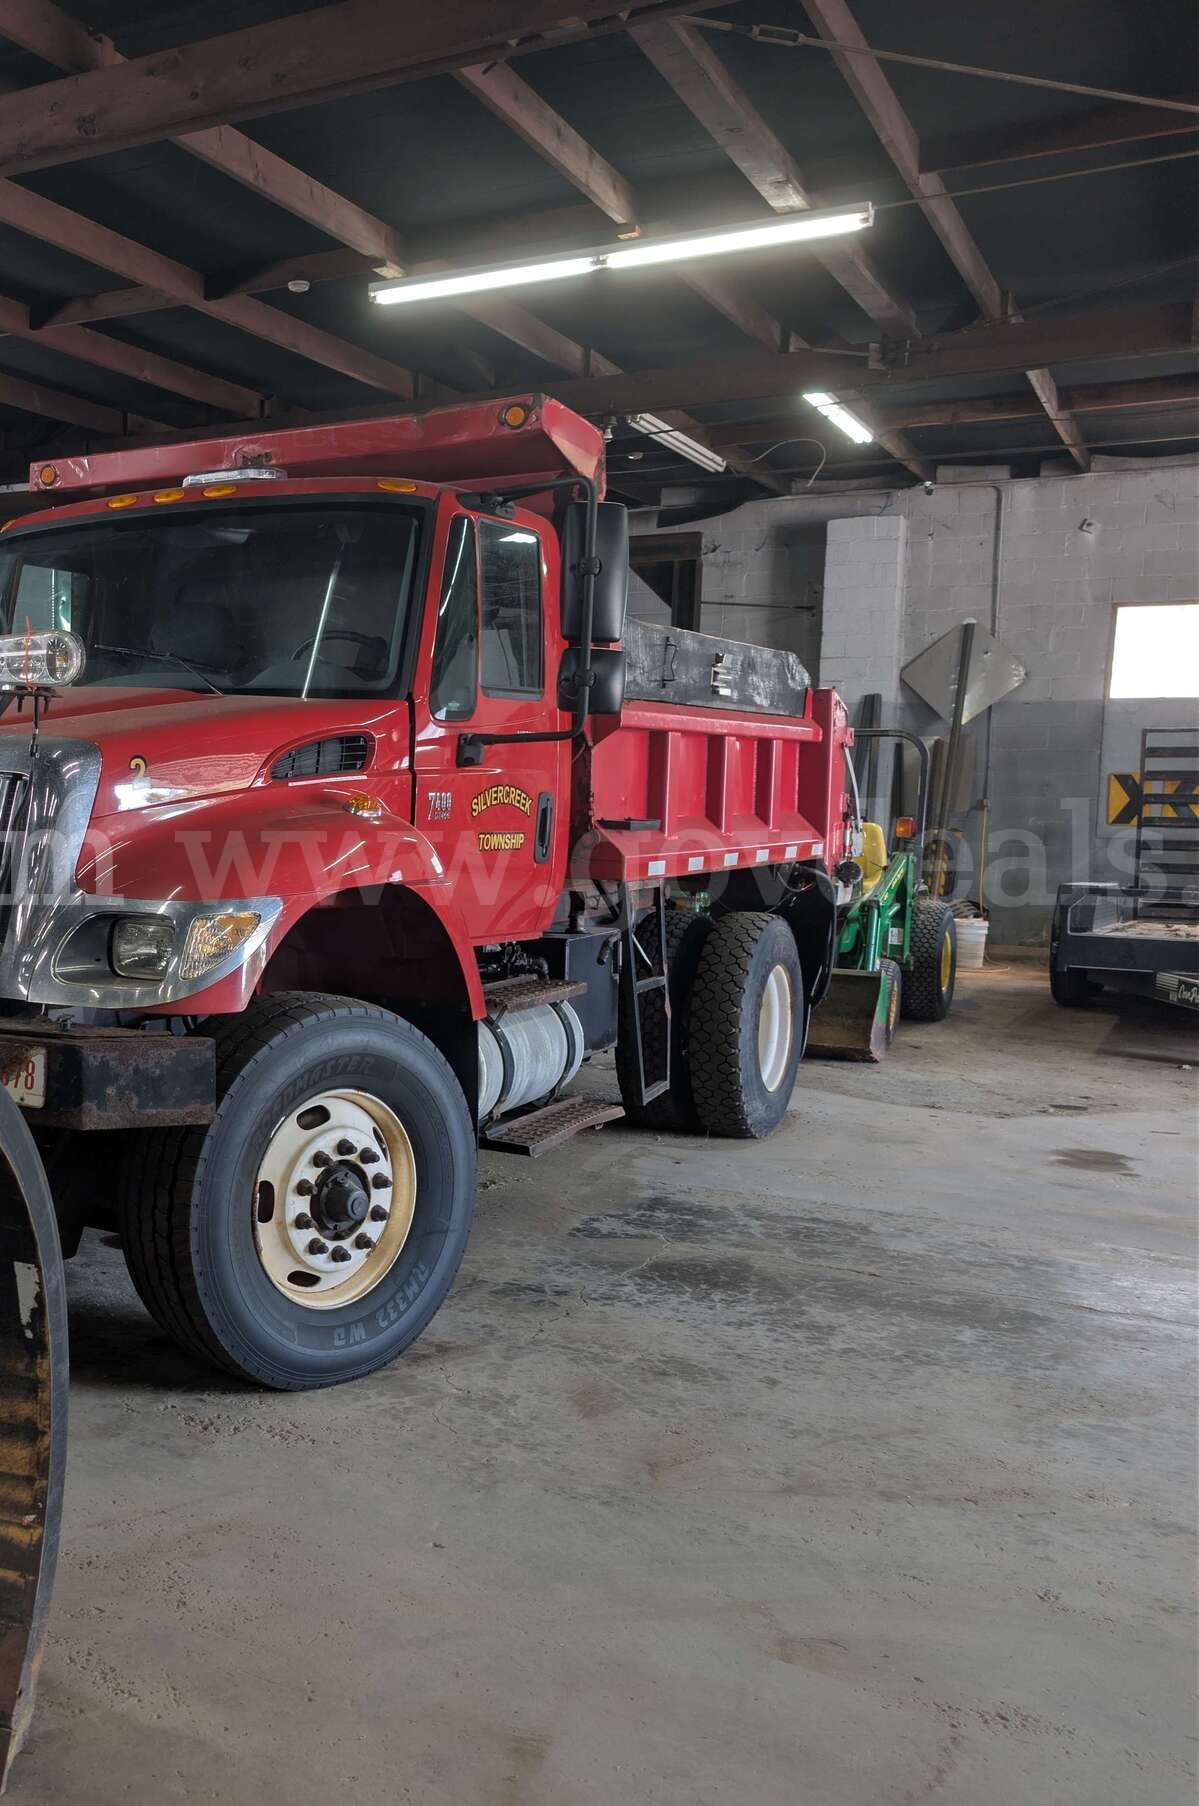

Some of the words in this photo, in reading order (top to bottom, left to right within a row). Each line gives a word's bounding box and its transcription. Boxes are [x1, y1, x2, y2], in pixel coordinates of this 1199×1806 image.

[129, 755, 150, 788] 2
[470, 784, 533, 817] SILVERCREEK
[478, 832, 526, 851] TOWNSHIP
